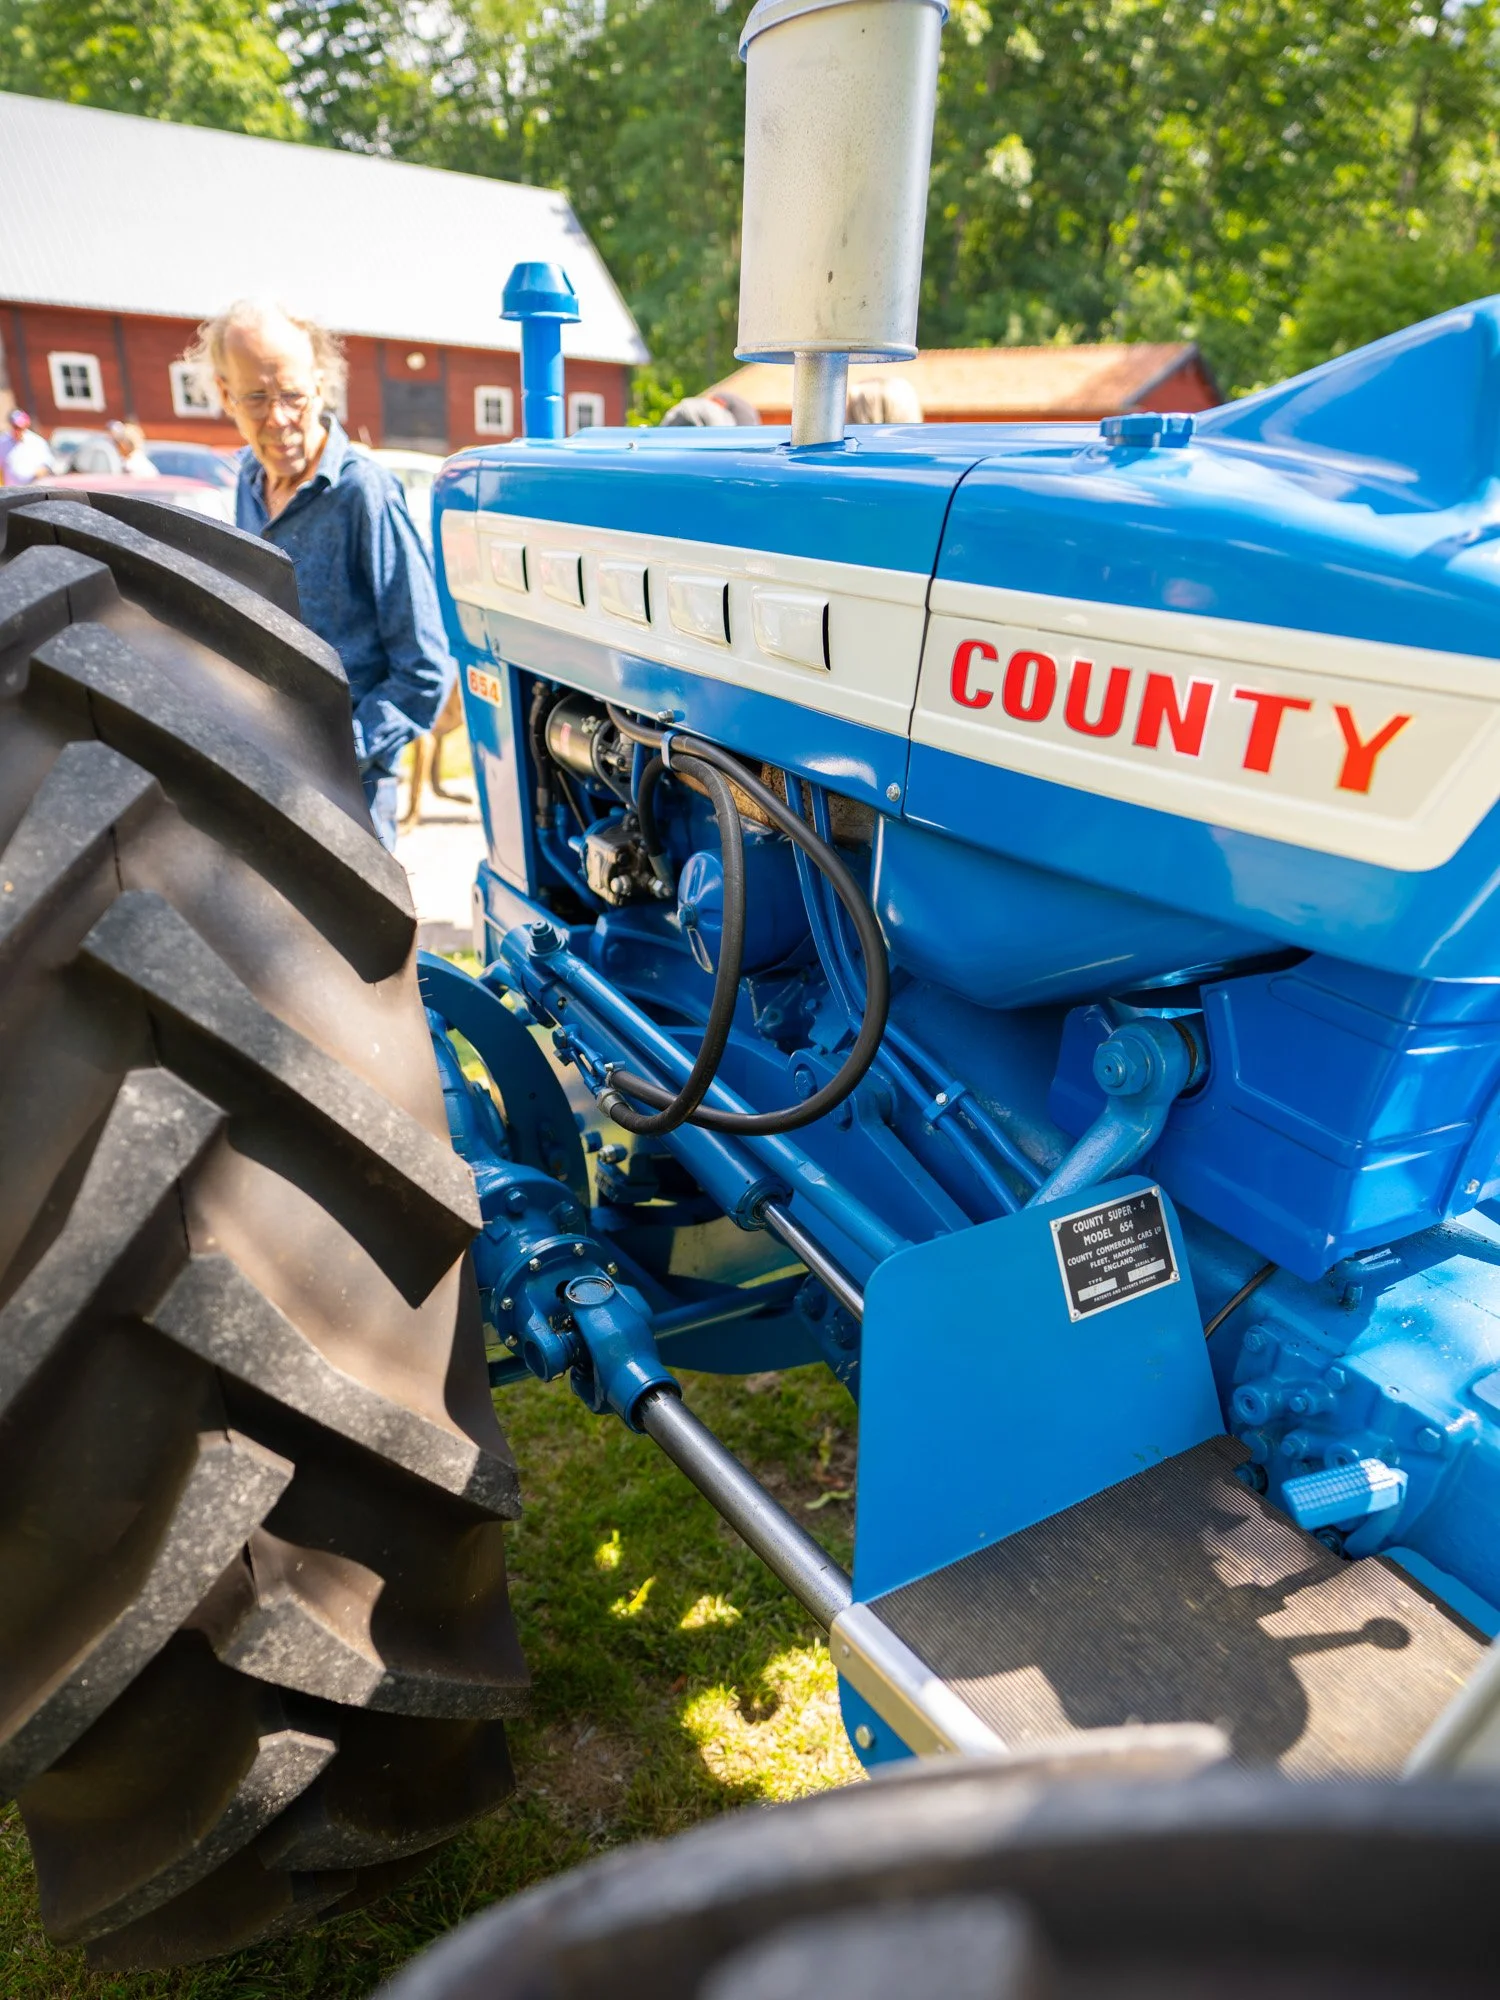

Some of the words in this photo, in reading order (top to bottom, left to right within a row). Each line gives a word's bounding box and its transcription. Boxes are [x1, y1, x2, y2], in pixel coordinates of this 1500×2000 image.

[469, 671, 499, 702] 654
[950, 638, 1414, 794] COUNTY
[1072, 1214, 1104, 1233] COUNTY
[1107, 1204, 1133, 1221] SUPER
[1140, 1200, 1146, 1210] 4
[1067, 1251, 1093, 1267] COUNTY
[1096, 1236, 1136, 1256] COMMERCIAL
[1137, 1229, 1153, 1241] CARS
[1083, 1228, 1113, 1246] MODEL
[1119, 1220, 1134, 1233] 654
[1103, 1256, 1136, 1273] ENGLAND.
[1088, 1277, 1103, 1286] TYPE
[1093, 1291, 1112, 1303] PATENTS
[1112, 1288, 1121, 1297] AND
[1121, 1280, 1139, 1291] PATENTS
[1138, 1274, 1156, 1286] PENDING
